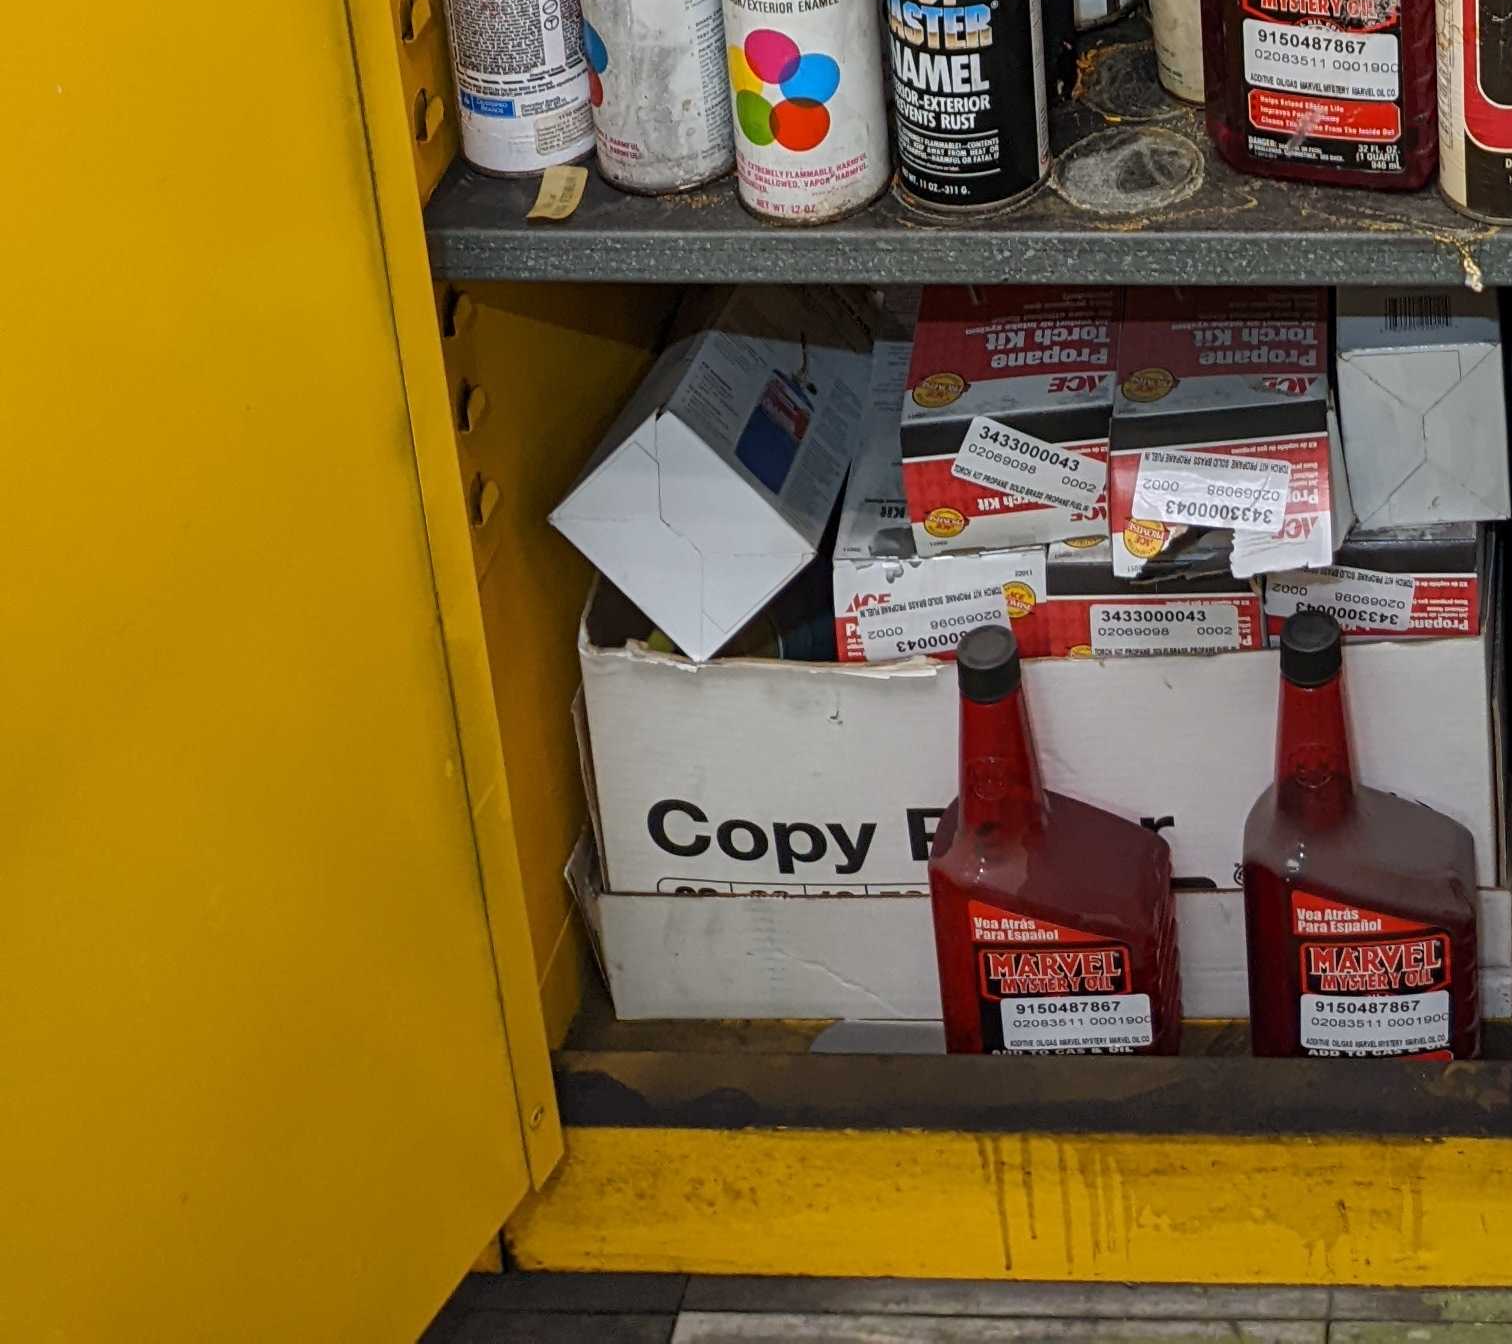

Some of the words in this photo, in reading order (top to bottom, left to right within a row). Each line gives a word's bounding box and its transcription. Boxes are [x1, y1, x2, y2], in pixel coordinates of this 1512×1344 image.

[1257, 29, 1367, 56] 9150487867
[1254, 48, 1326, 70] 02083511
[941, 113, 976, 130] RUST
[984, 333, 1025, 351] Kit
[1033, 326, 1111, 344] Torch
[990, 347, 1109, 369] Propane
[1199, 347, 1317, 366] Propane
[1048, 375, 1109, 393] ACE
[979, 425, 1080, 472] 3433000043
[968, 443, 1037, 475] 02069098
[1061, 476, 1097, 494] 0002
[1143, 479, 1180, 492] 0002
[1207, 484, 1280, 502] 02069098
[1166, 499, 1273, 524] 3433000043
[1100, 609, 1207, 623] 3433000043
[1097, 627, 1170, 637] 02069098
[1196, 625, 1233, 636] 0002
[647, 799, 878, 874] Copy
[987, 951, 1121, 980] MARVEL
[1310, 940, 1442, 975] MARVEL
[1001, 976, 1081, 994] MYSTERY
[1084, 975, 1114, 992] OIL
[1320, 971, 1401, 991] MYSTERY
[1404, 968, 1434, 987] OIL
[1016, 1001, 1121, 1015] 9150487867
[1315, 1000, 1421, 1013] 9150487867
[1012, 1018, 1084, 1028] 02083511
[1311, 1016, 1382, 1028] 02083511
